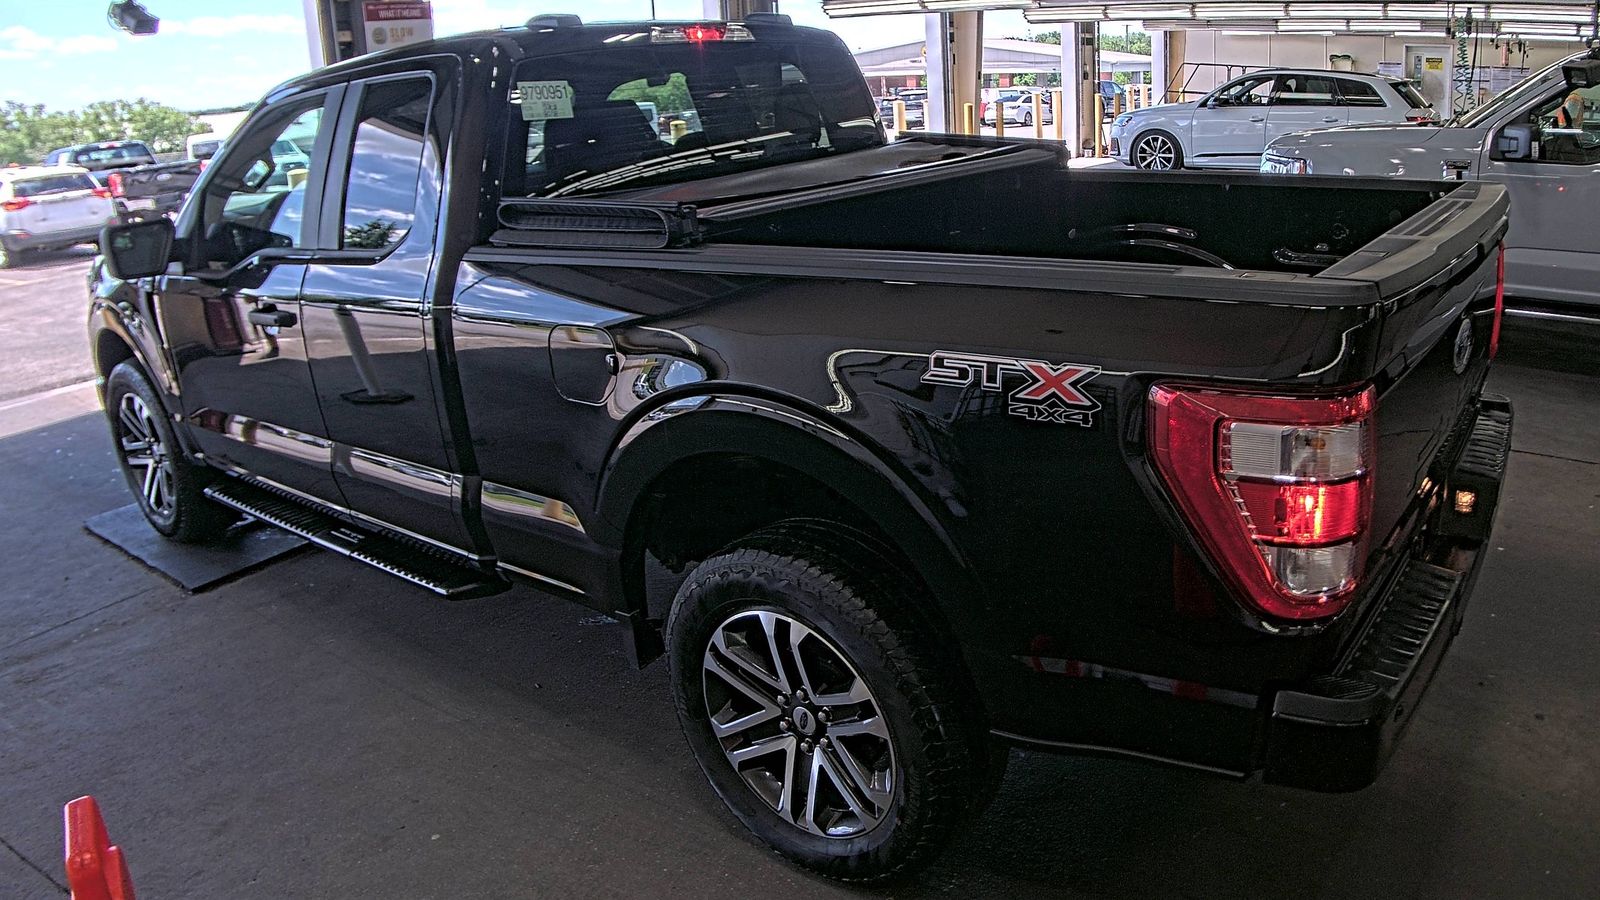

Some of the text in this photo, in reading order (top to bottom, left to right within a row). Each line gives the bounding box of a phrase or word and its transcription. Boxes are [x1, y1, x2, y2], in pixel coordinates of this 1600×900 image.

[378, 9, 395, 18] WHAT
[520, 85, 568, 100] 9790951
[920, 349, 1102, 413] STX
